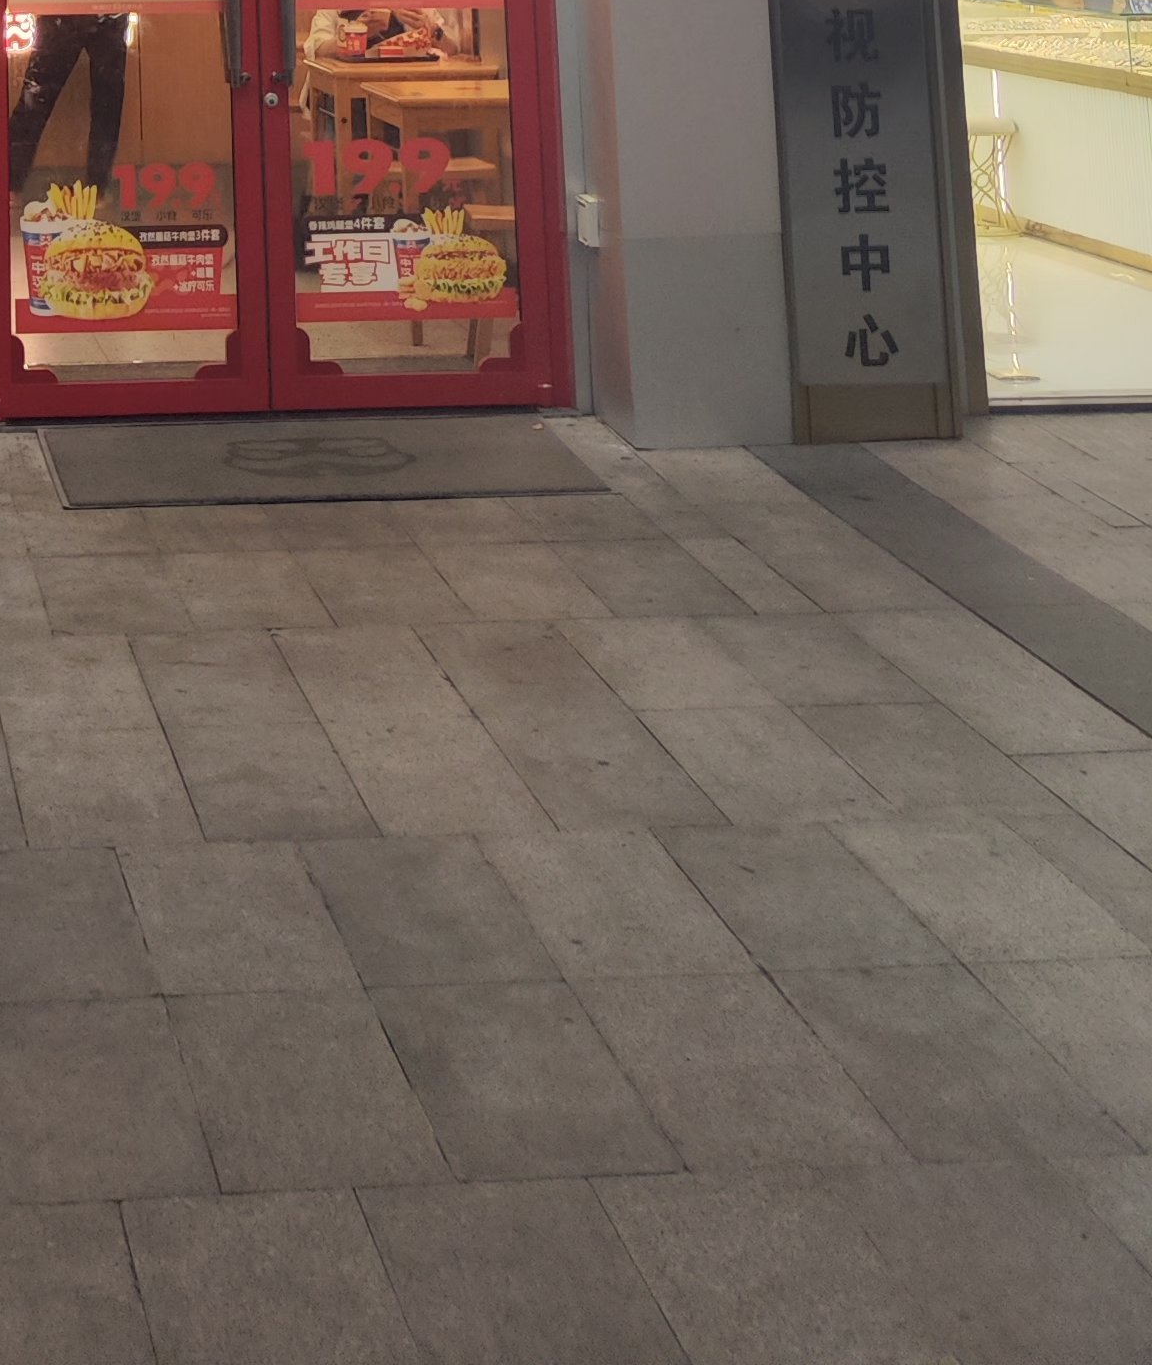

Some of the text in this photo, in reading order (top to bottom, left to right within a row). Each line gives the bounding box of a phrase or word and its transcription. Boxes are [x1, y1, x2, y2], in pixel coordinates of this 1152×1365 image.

[304, 238, 391, 265] 工作日
[319, 261, 378, 286] 专享
